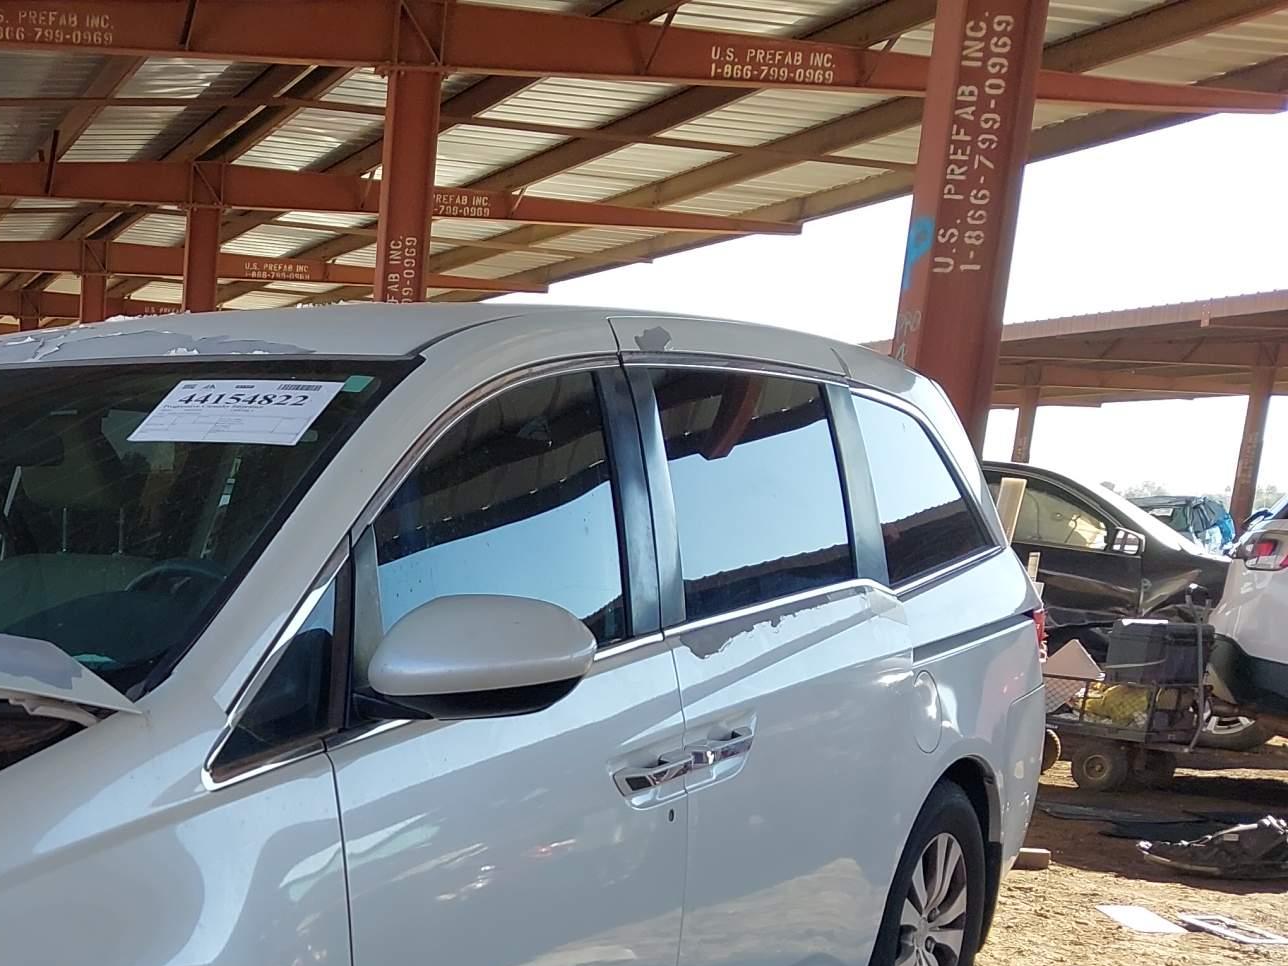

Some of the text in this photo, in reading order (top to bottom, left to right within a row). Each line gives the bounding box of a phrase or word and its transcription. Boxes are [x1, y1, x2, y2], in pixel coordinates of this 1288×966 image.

[18, 10, 78, 27] PREFAB
[86, 15, 114, 29] INC.
[712, 46, 836, 68] U.S. PREFAB INC.
[711, 63, 833, 84] 1-866-799-0969
[932, 11, 989, 273] U.S. PREFAB INC.
[960, 15, 1014, 271] 1-866-799-0969
[433, 193, 468, 205] REFAB
[389, 235, 403, 264] INC.
[263, 263, 293, 272] PREFAB
[178, 393, 309, 407] 44154822
